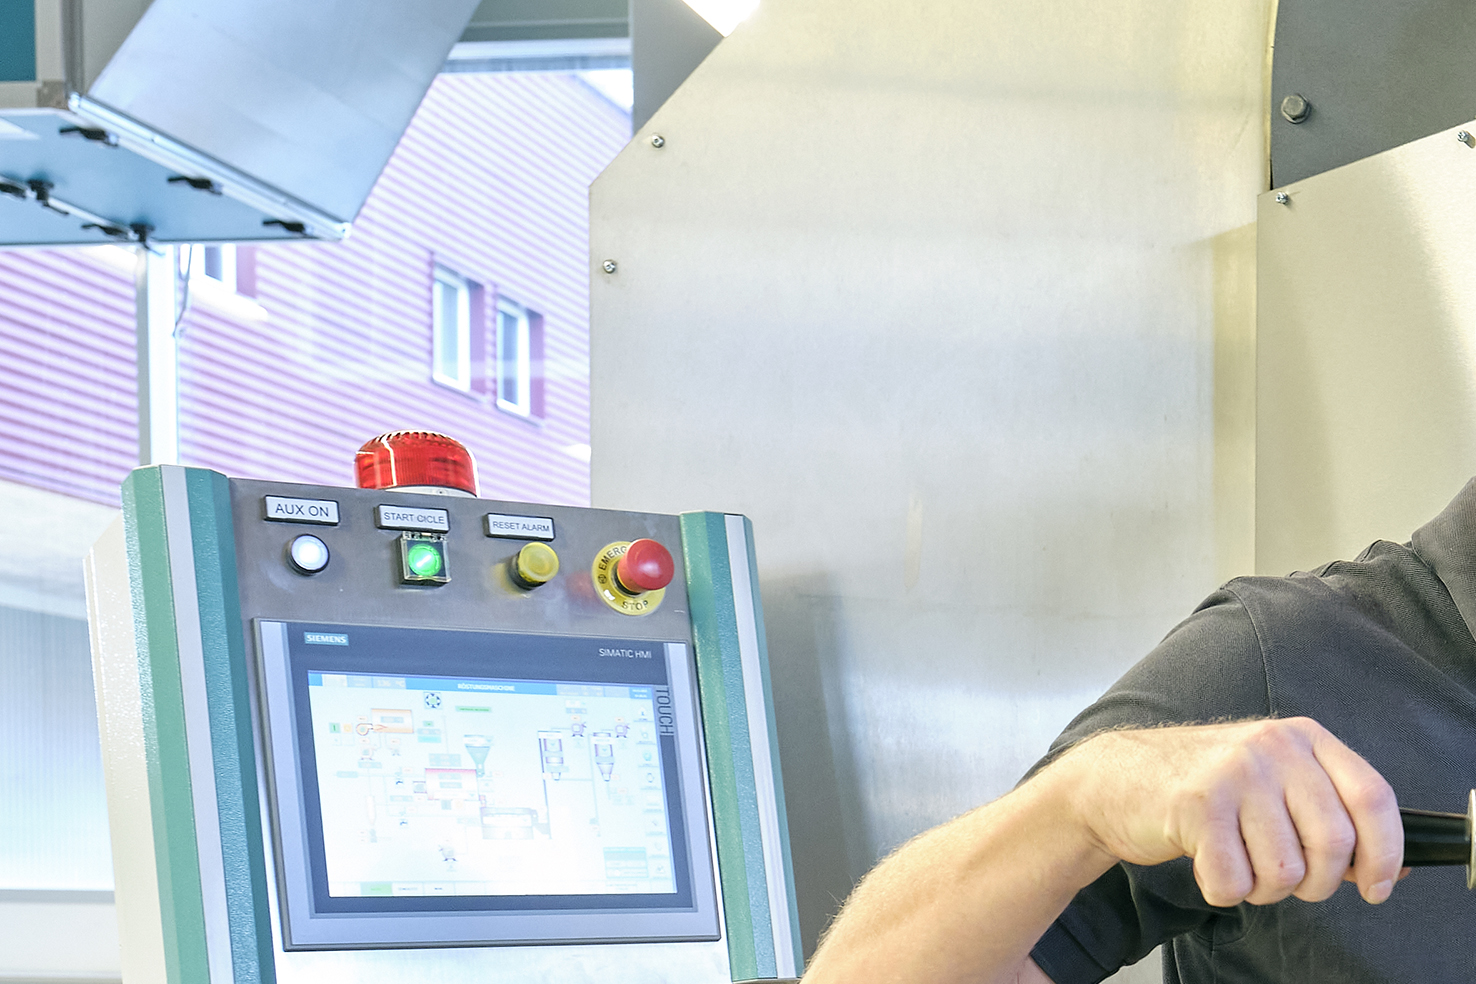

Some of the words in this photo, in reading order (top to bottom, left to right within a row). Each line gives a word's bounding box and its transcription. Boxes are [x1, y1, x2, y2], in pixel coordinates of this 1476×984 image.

[275, 503, 305, 516] AUX
[308, 505, 329, 517] ON
[383, 512, 415, 522] START
[416, 514, 446, 525] CICLE
[492, 521, 520, 530] RESET
[521, 523, 550, 532] ALARM
[621, 600, 649, 611] STOP
[306, 634, 347, 644] SIEMENS
[598, 648, 634, 658] SIMATIC
[634, 650, 652, 659] HMI
[656, 686, 674, 734] TOUCH
